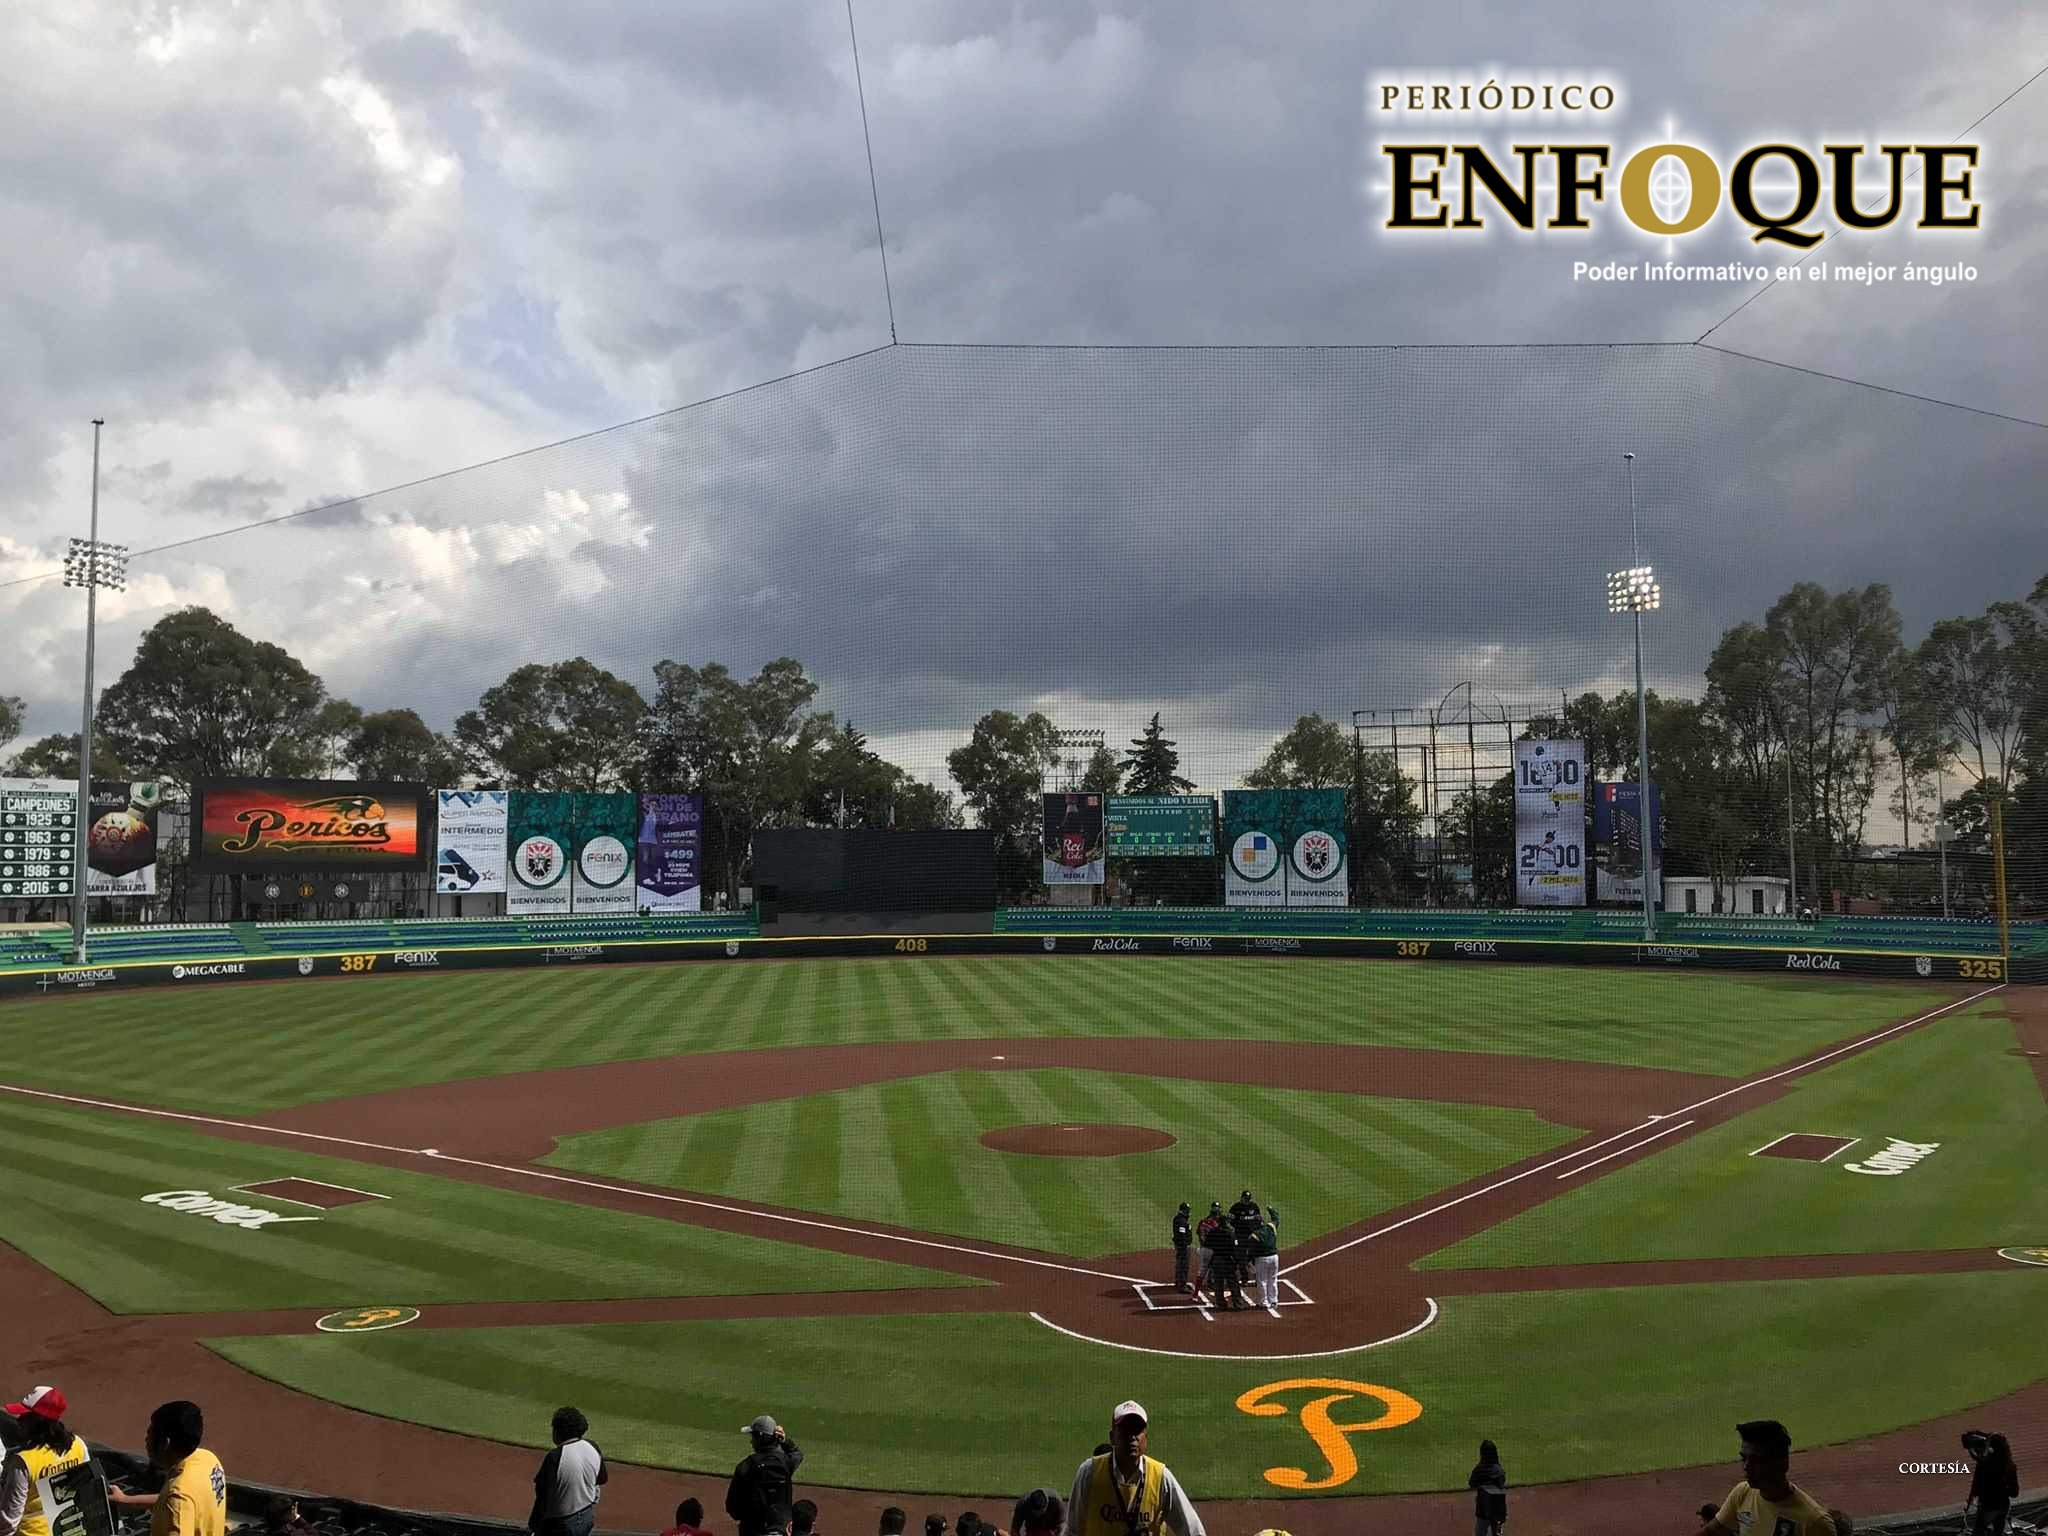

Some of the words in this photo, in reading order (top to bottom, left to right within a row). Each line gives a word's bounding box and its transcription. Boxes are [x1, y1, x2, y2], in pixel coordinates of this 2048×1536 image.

[7, 798, 71, 812] CAMPEONES
[26, 814, 52, 826] 1925
[223, 809, 391, 852] Pericos
[441, 827, 505, 835] INTERMEDIO
[25, 831, 51, 844] 1963
[1063, 838, 1082, 851] Red
[24, 848, 51, 861] 1979
[664, 849, 694, 859] $499
[23, 865, 50, 877] 1986
[22, 881, 49, 894] 2016
[1229, 889, 1281, 897] BIENVENIDOS
[1291, 889, 1344, 897] BIENVENIDOS
[511, 897, 567, 905] BIENVENIDOS
[576, 896, 631, 904] BIENVENIDOS
[895, 938, 928, 952] 408
[1114, 938, 1141, 950] Cola
[1397, 941, 1431, 956] 387
[340, 955, 377, 971] 387
[1811, 954, 1841, 969] Cola
[184, 963, 246, 977] MEGACABLE
[1959, 959, 2002, 978] 325
[1235, 1378, 1424, 1489] P
